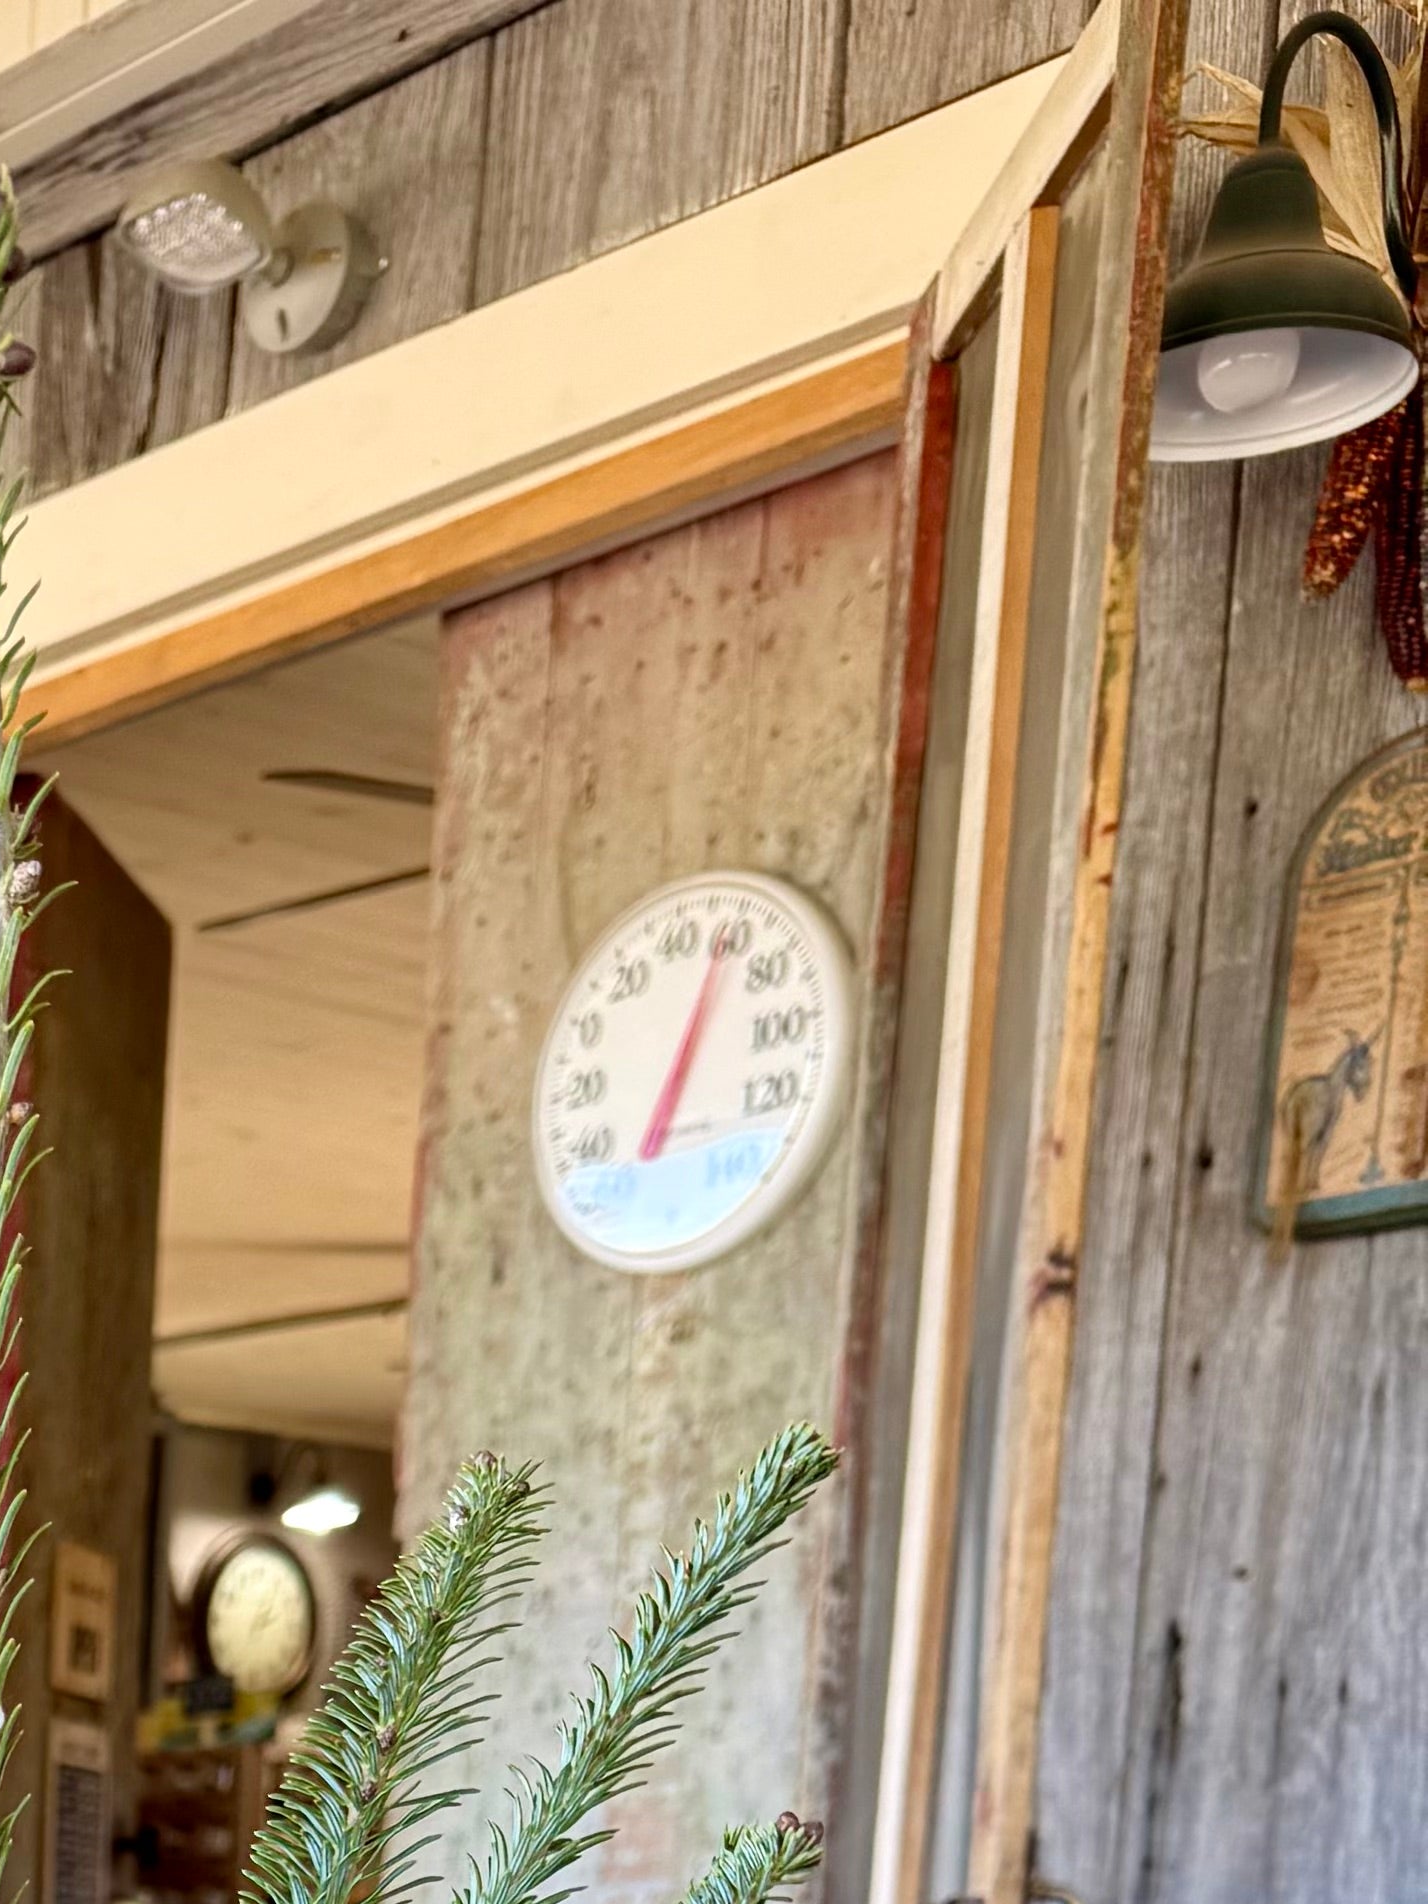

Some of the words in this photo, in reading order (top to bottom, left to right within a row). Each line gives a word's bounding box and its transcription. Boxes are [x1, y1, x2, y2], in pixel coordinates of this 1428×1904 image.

[656, 920, 699, 961] 40
[712, 918, 753, 962] 60
[609, 960, 651, 1004] 20
[746, 949, 789, 993] 80
[579, 1011, 603, 1048] 0
[752, 1005, 806, 1052] 100
[743, 1070, 799, 1118] 120
